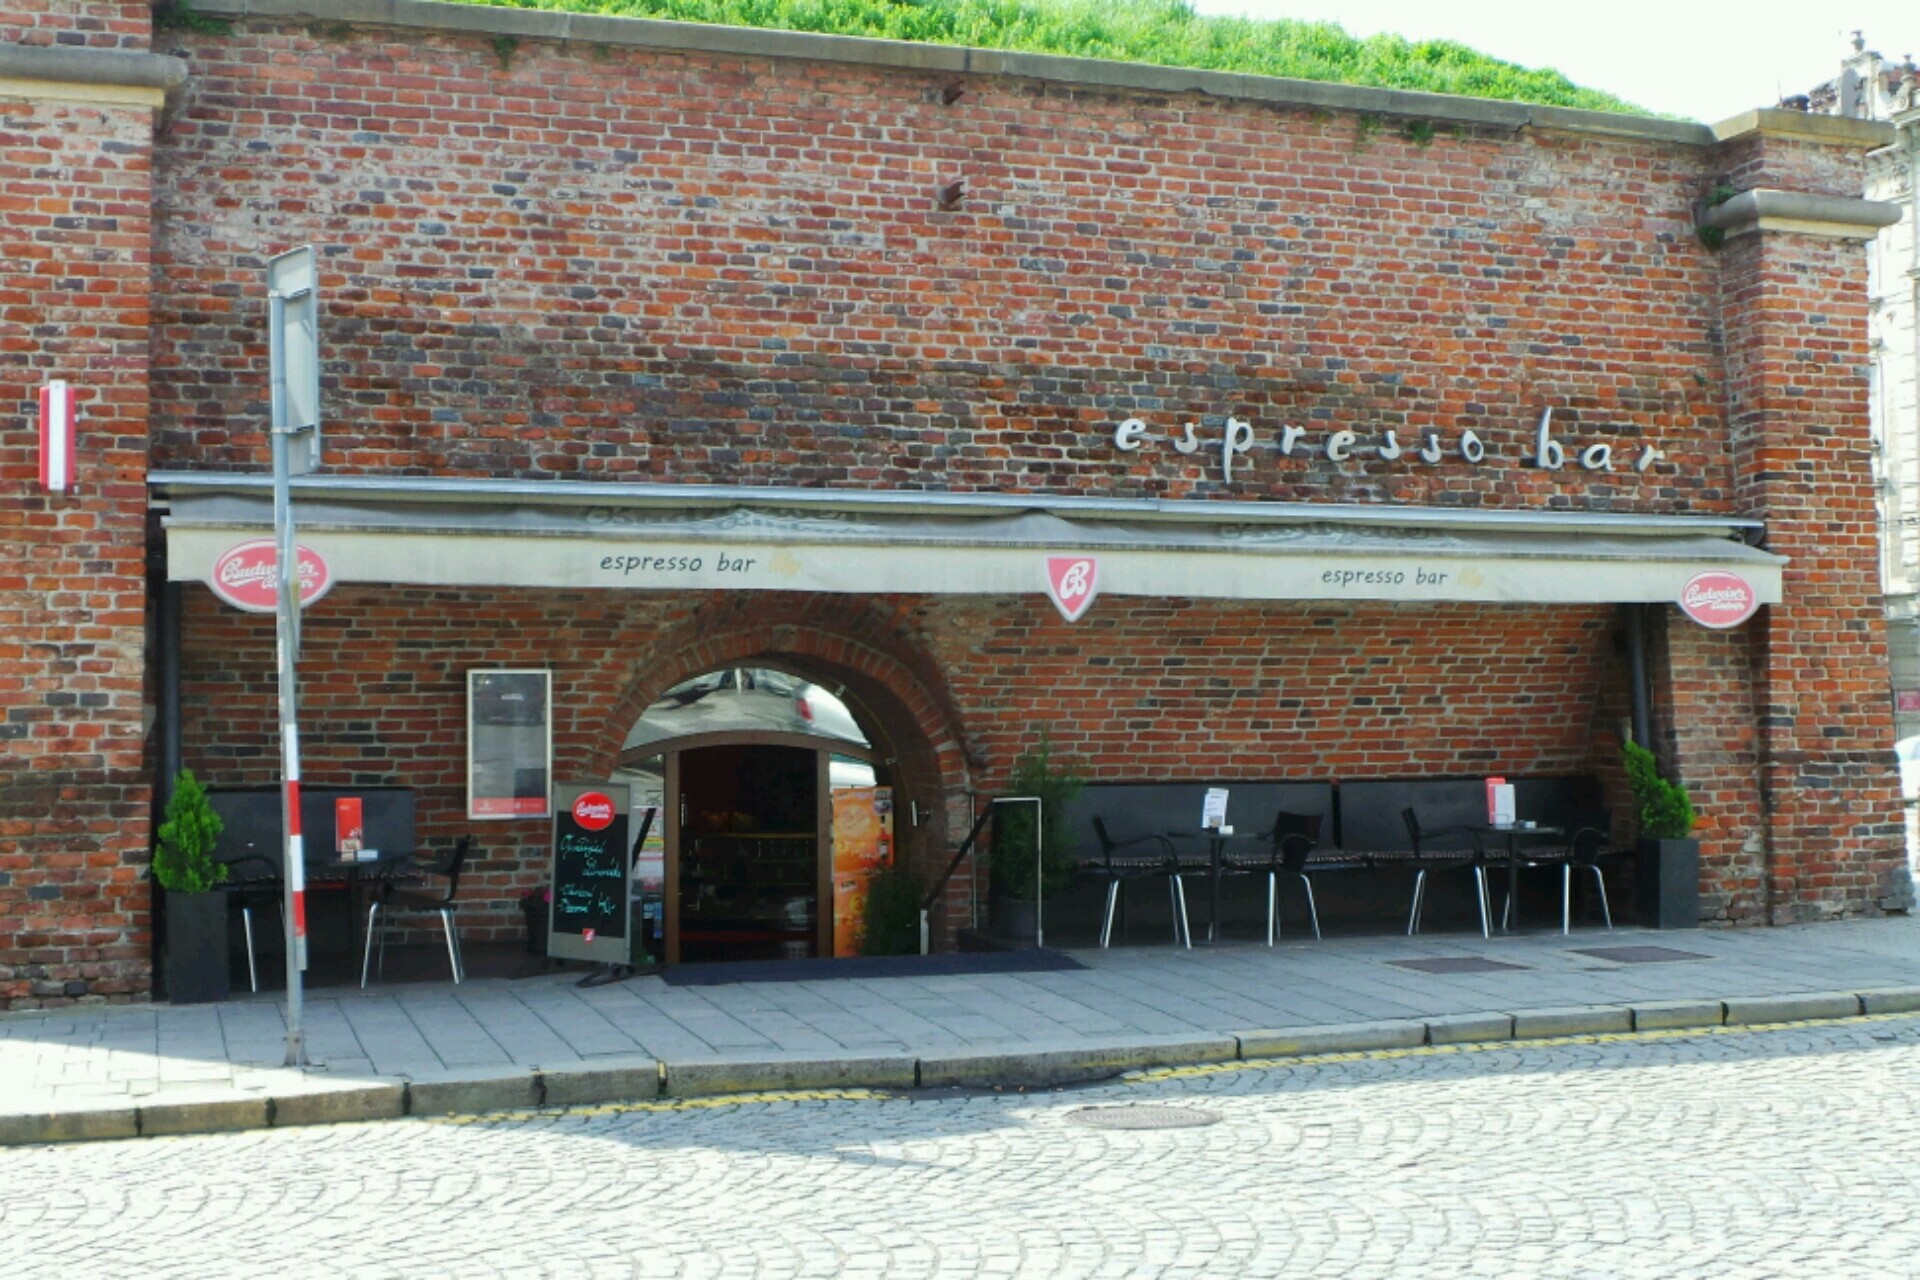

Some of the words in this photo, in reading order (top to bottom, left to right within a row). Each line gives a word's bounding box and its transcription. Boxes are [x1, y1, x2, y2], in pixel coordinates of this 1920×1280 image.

[1114, 417, 1485, 485] espresso
[1536, 406, 1666, 472] bar
[599, 552, 703, 576] espresso
[716, 551, 757, 573] bar
[1321, 568, 1406, 587] espresso
[1415, 567, 1449, 585] bar
